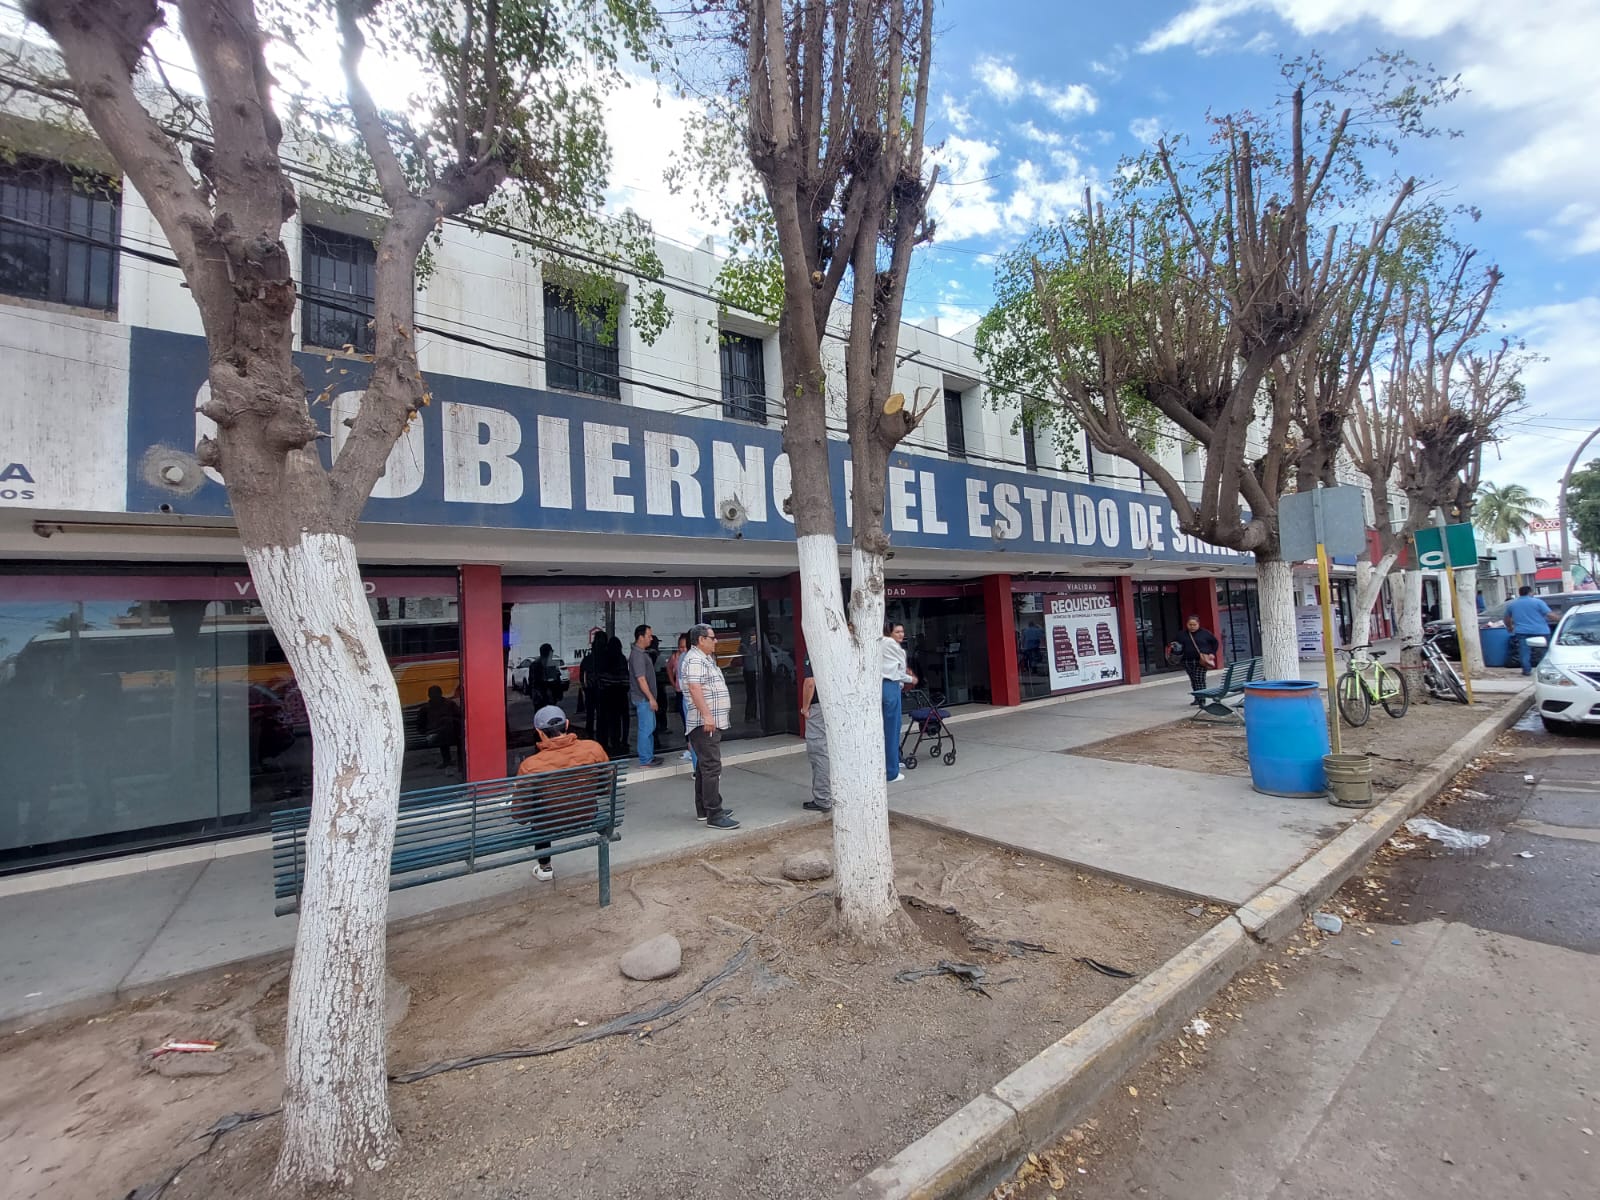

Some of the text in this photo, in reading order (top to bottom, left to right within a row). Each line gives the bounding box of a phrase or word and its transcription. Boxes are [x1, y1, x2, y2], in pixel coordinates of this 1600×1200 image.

[844, 460, 949, 535] EL
[966, 478, 1120, 548] ESTADO
[1129, 502, 1165, 551] DE
[606, 588, 682, 599] VIALIDAD
[1066, 583, 1097, 591] VIALIDAD
[1050, 595, 1111, 614] REQUISITOS
